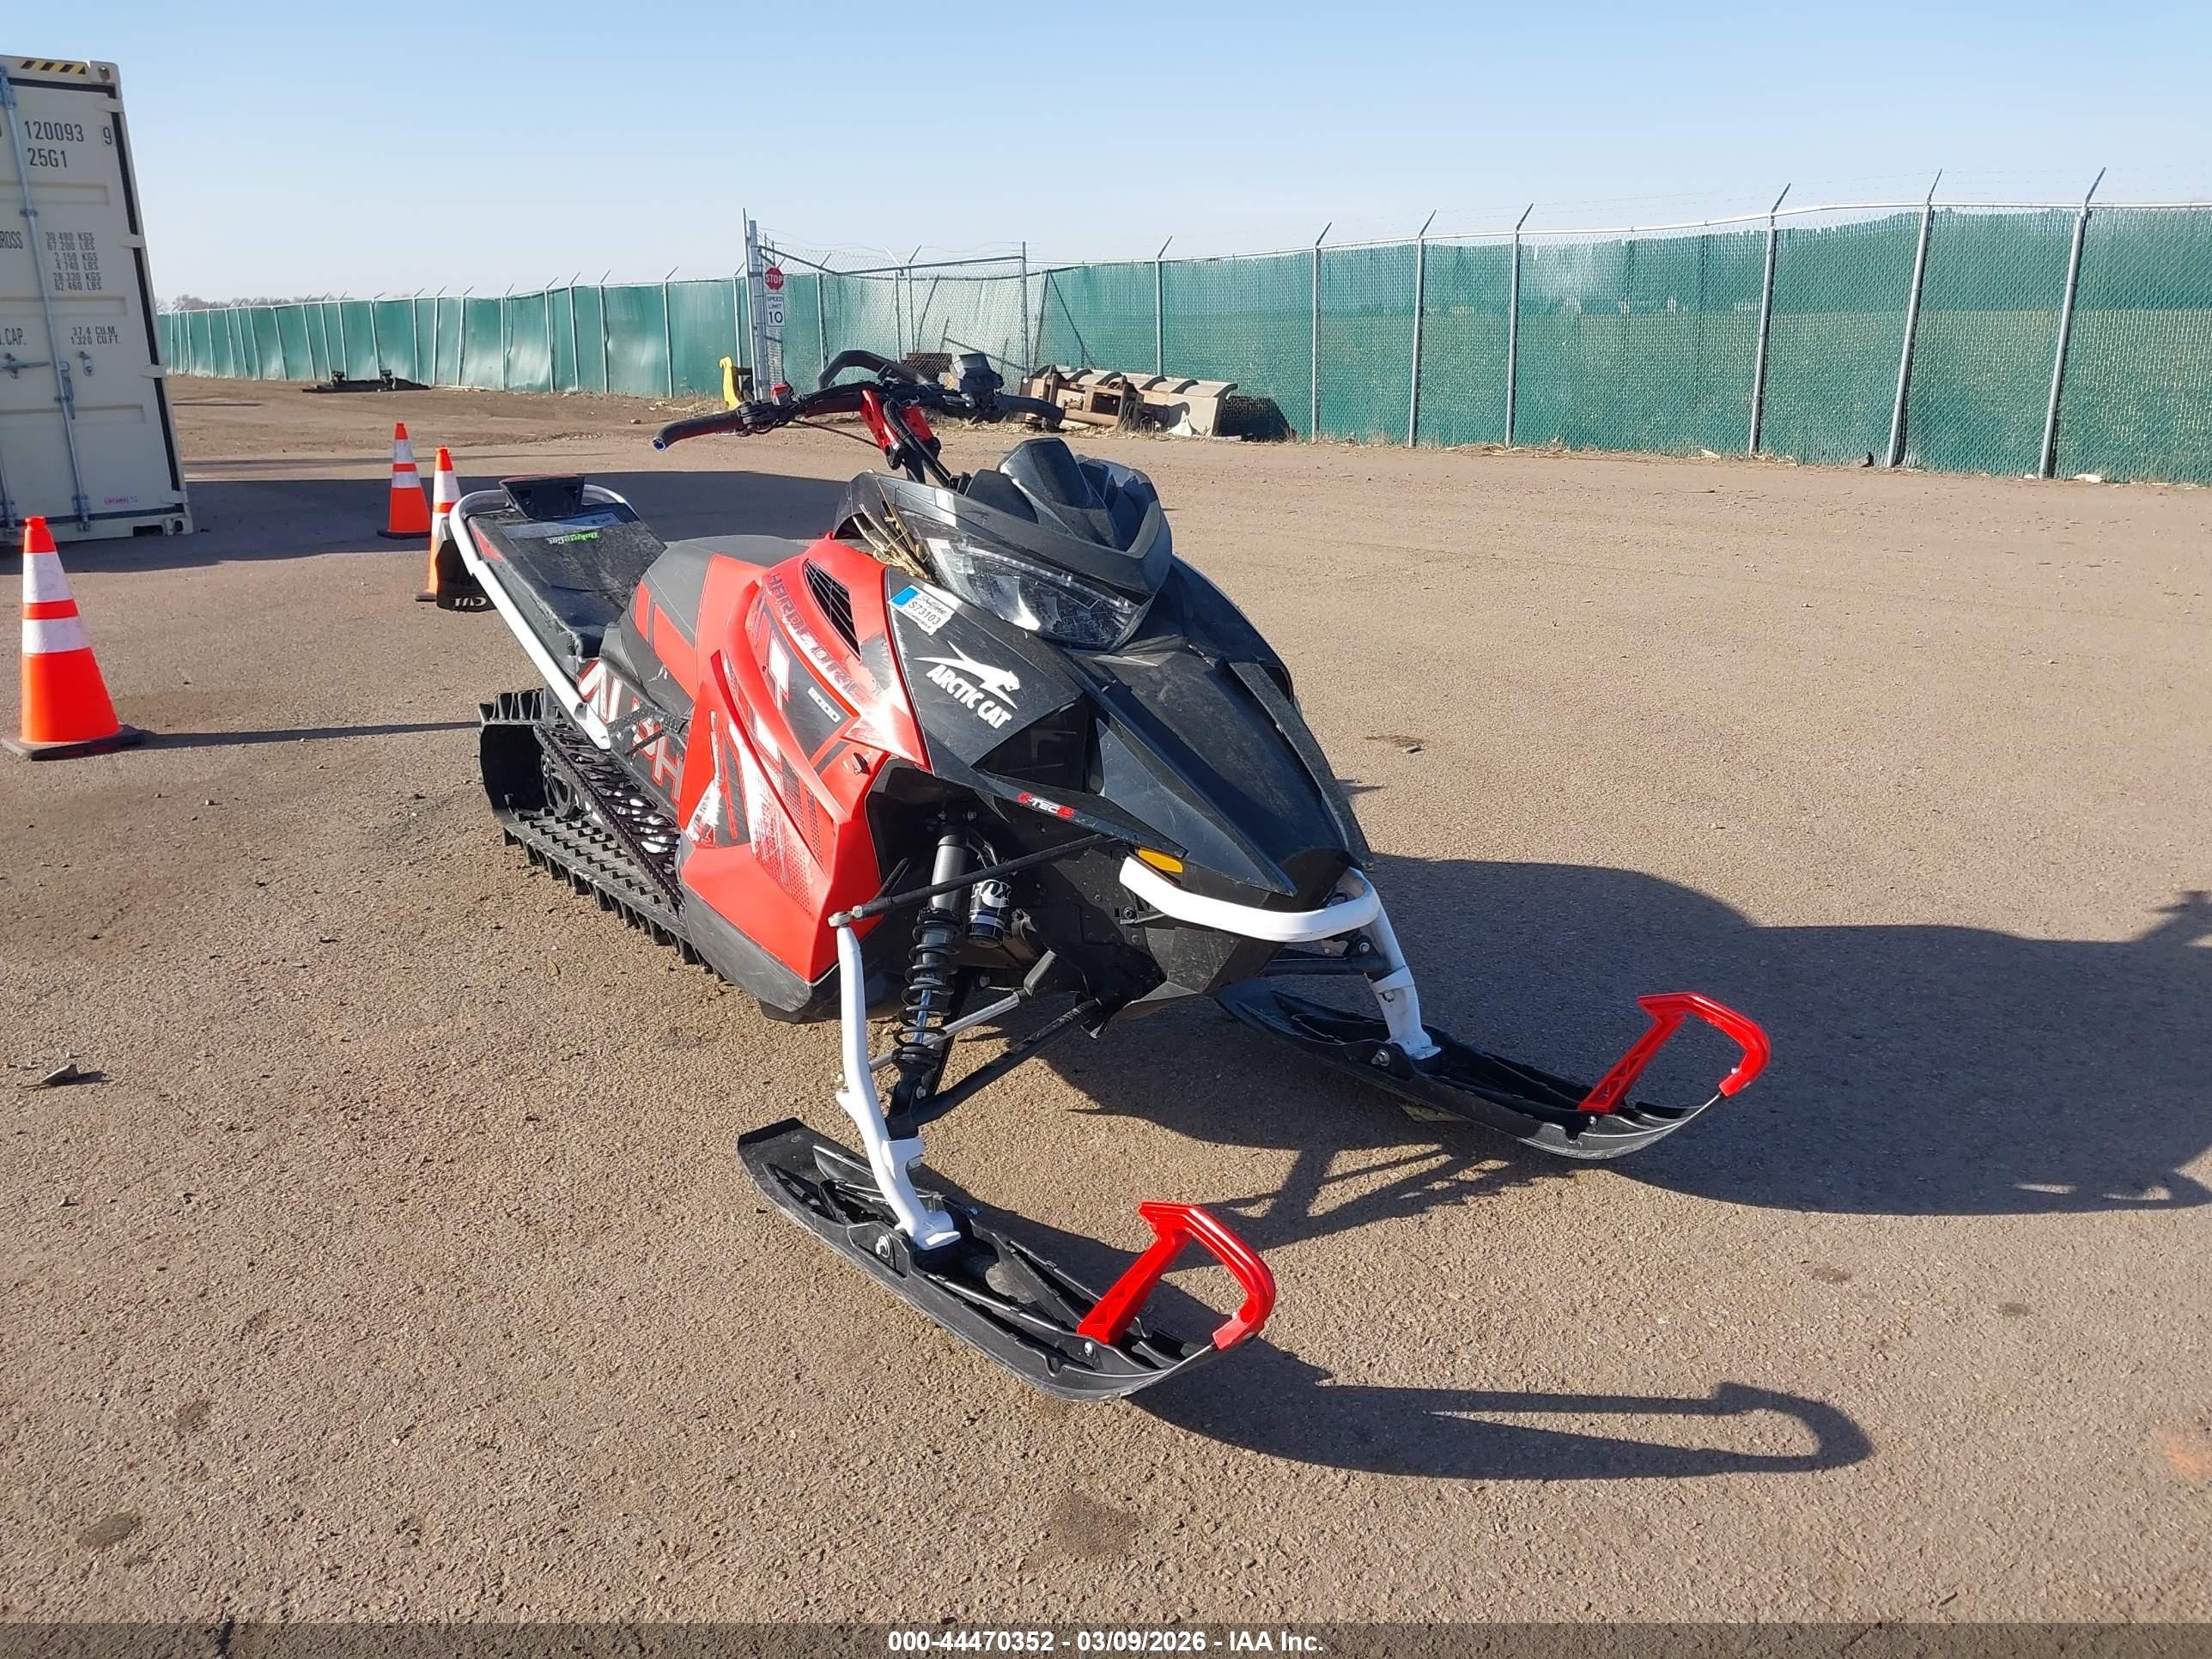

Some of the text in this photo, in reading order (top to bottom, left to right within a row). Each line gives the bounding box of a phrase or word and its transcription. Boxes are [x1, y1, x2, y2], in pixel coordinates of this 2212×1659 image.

[24, 120, 84, 143] 120093
[102, 126, 112, 145] 9
[27, 148, 68, 168] 25G1
[83, 261, 99, 270] LBS
[87, 281, 102, 290] LBS
[765, 273, 783, 283] STOP
[769, 311, 783, 324] 10
[908, 601, 941, 626] S73103
[926, 664, 1012, 729] ARCTIC CAT
